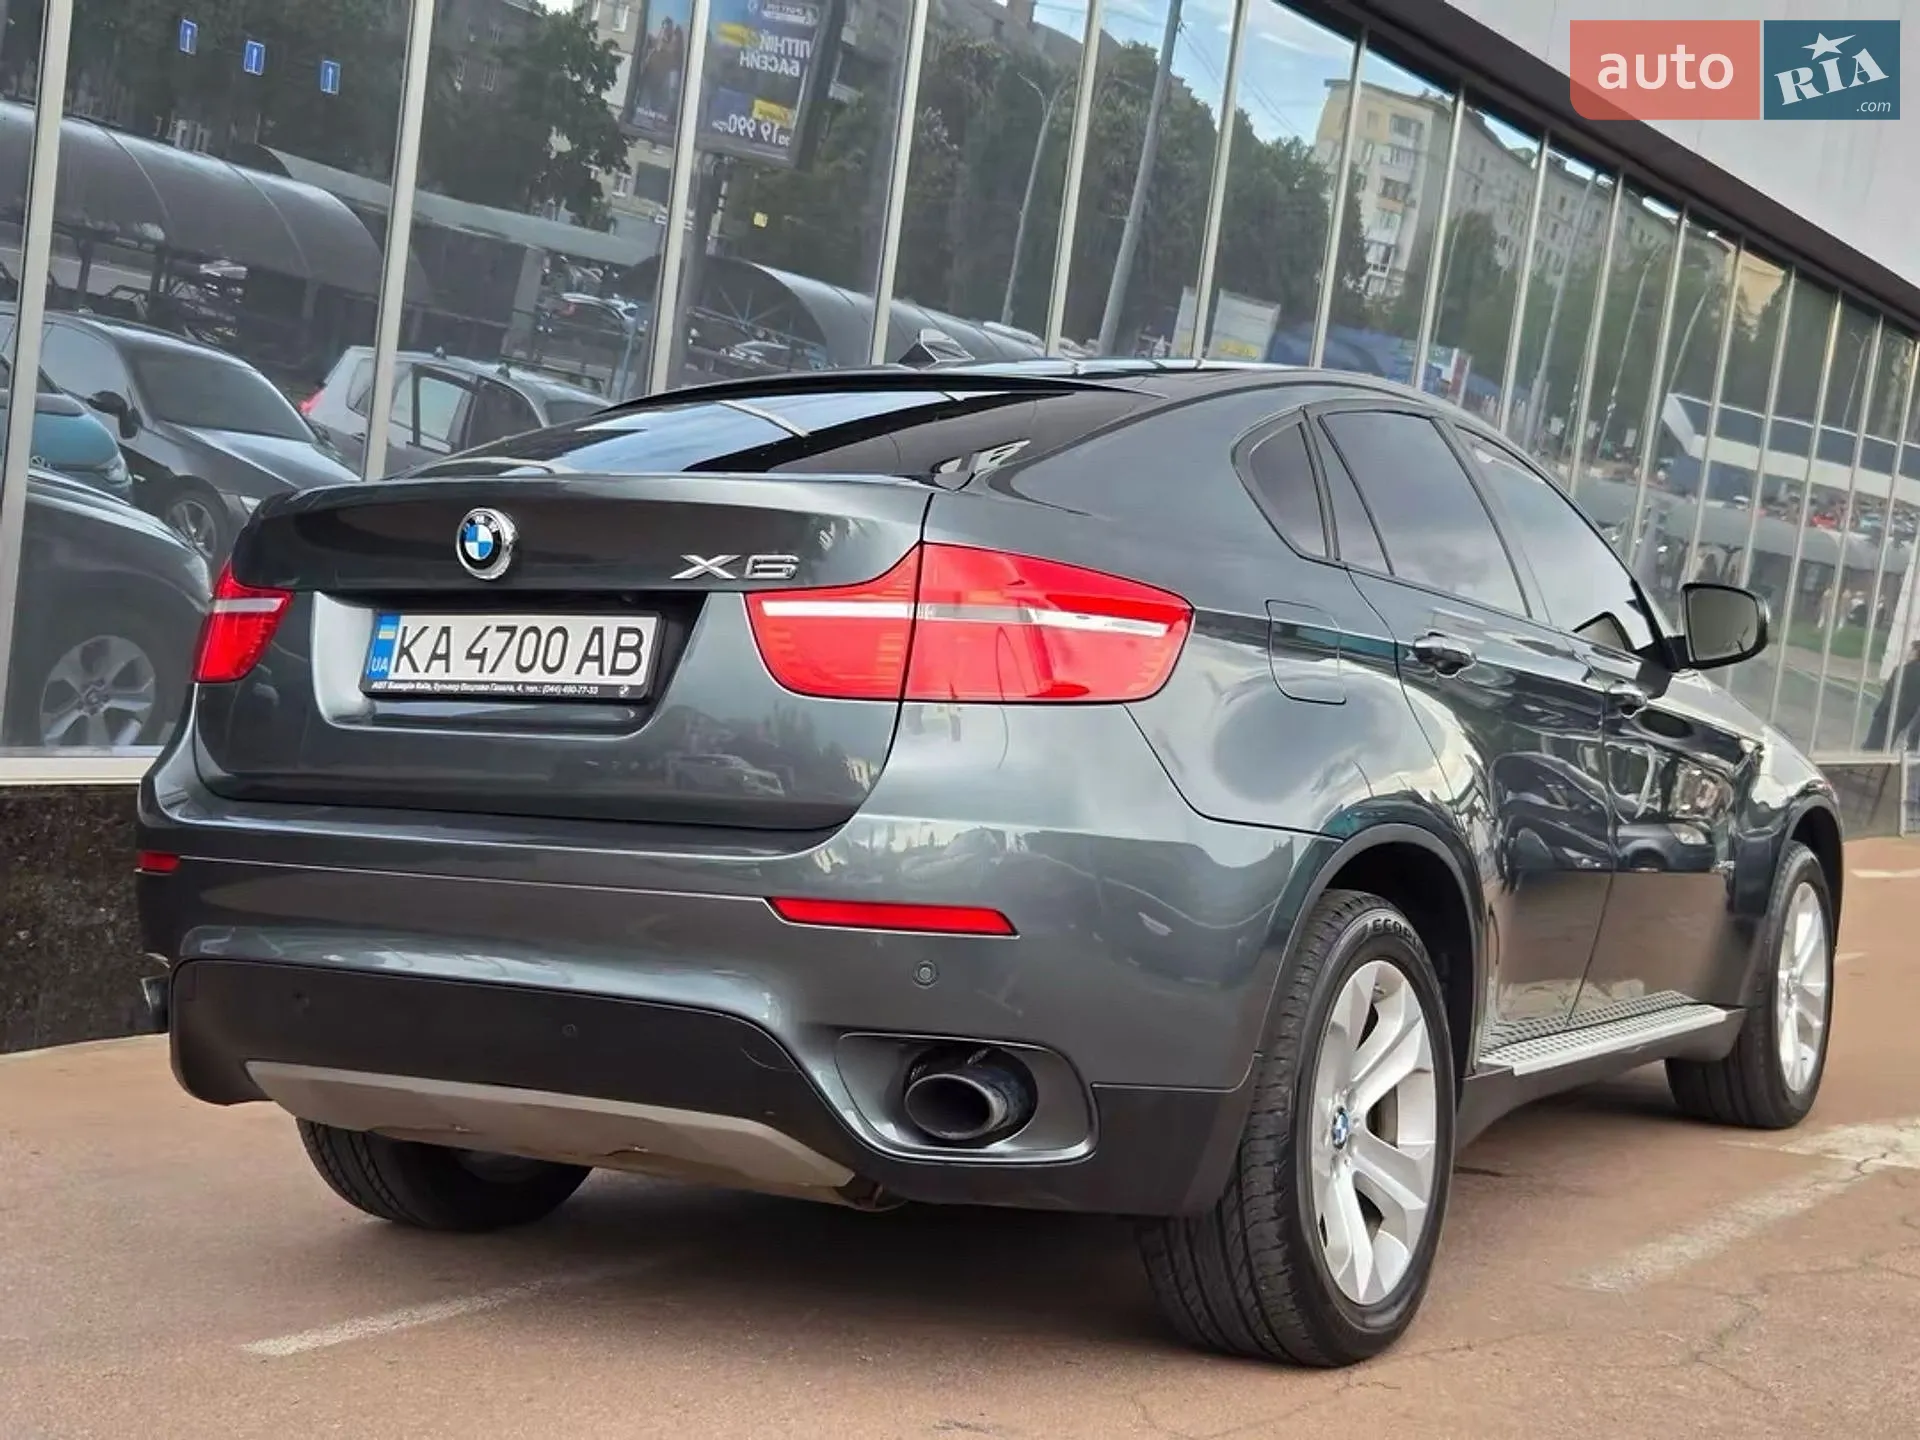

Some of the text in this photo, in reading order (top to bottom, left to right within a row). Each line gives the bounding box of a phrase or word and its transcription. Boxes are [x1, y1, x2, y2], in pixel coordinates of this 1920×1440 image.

[670, 554, 800, 580] X6
[371, 656, 388, 672] UA
[394, 625, 645, 677] KA 4700 AB
